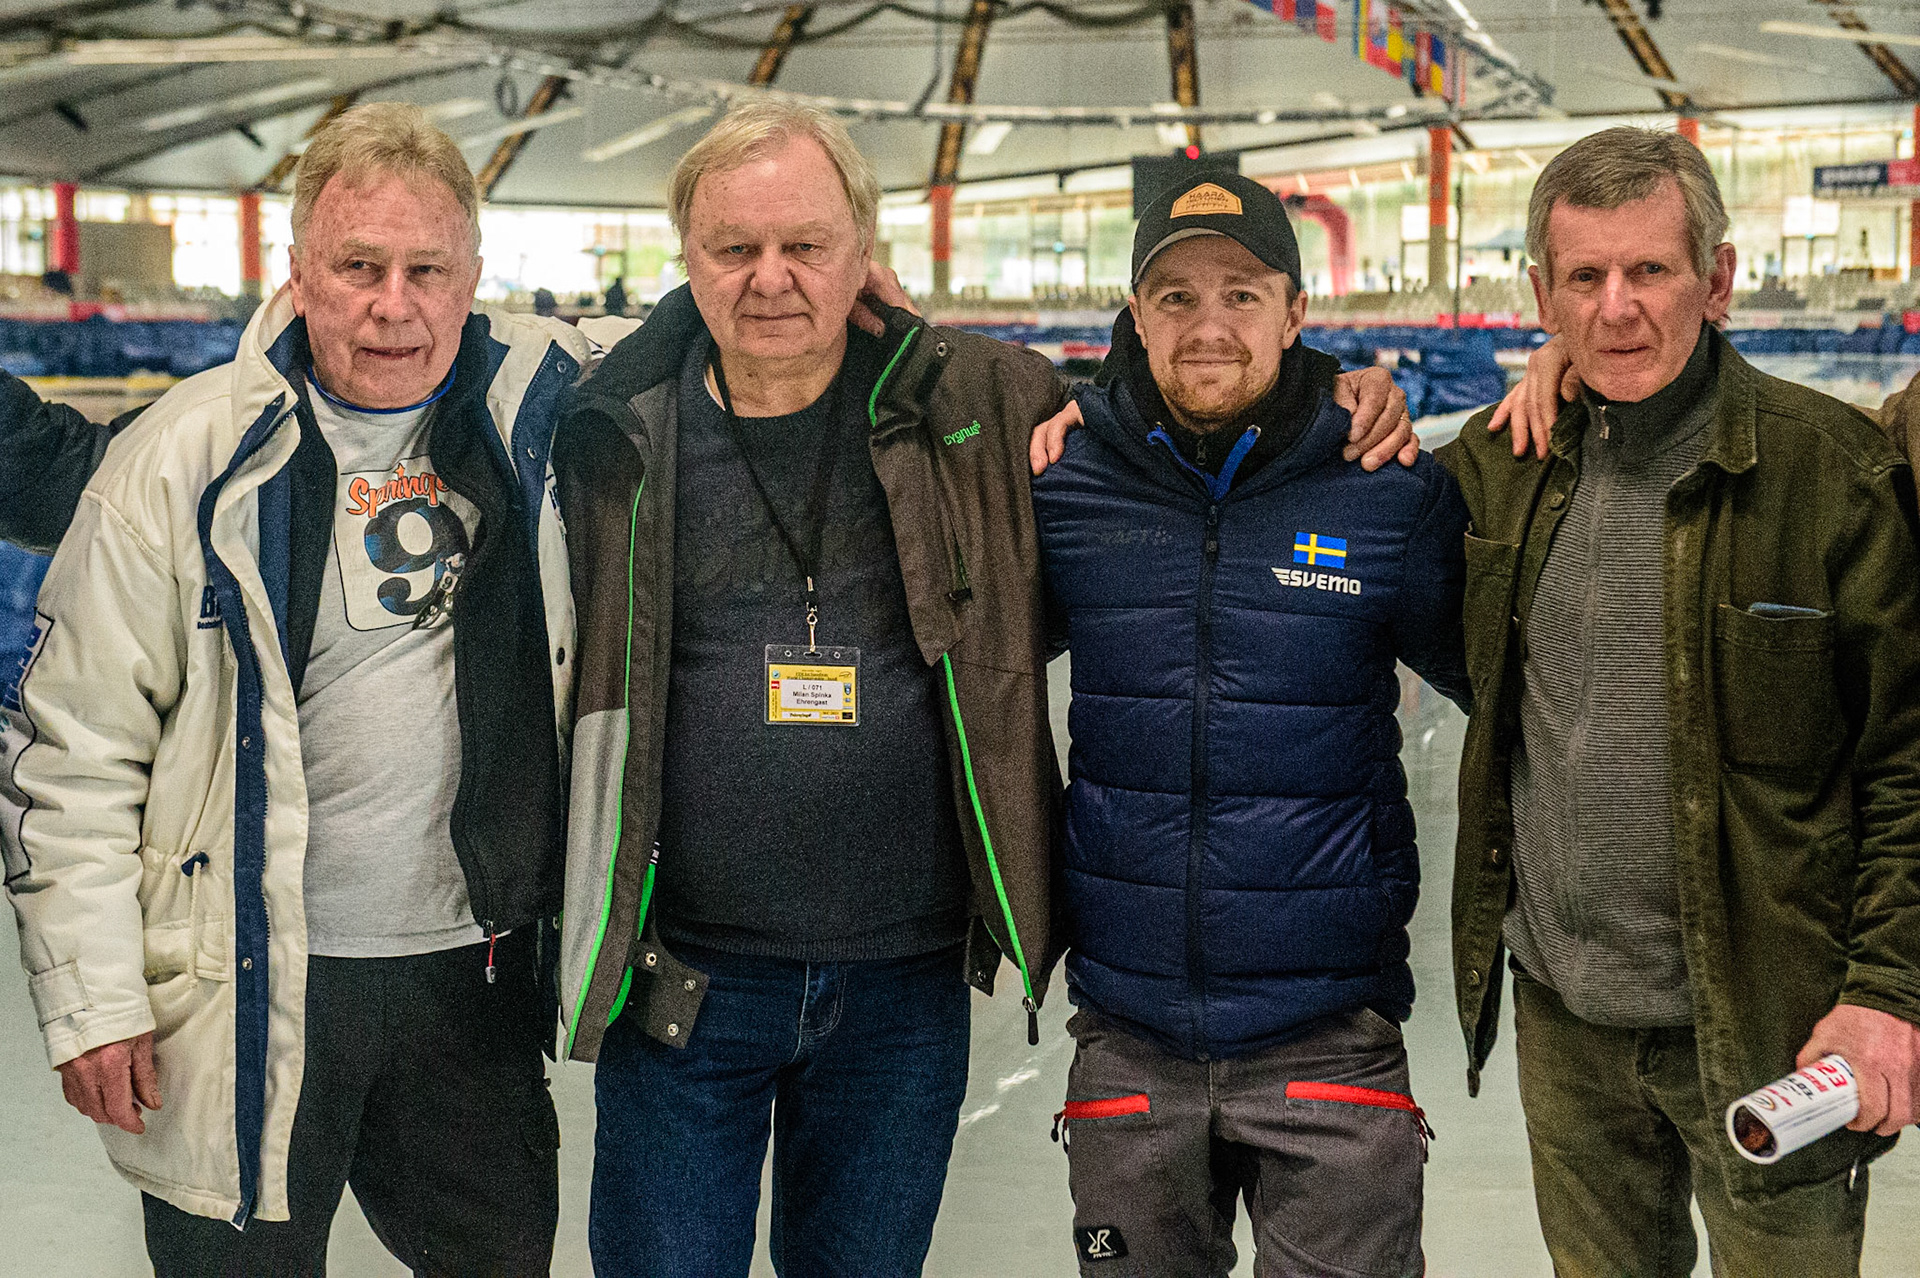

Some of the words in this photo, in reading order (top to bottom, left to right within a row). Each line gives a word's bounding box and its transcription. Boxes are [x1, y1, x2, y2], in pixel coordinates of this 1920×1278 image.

[943, 425, 980, 445] cygnus
[364, 498, 471, 616] 9
[1289, 569, 1361, 595] SVEMO
